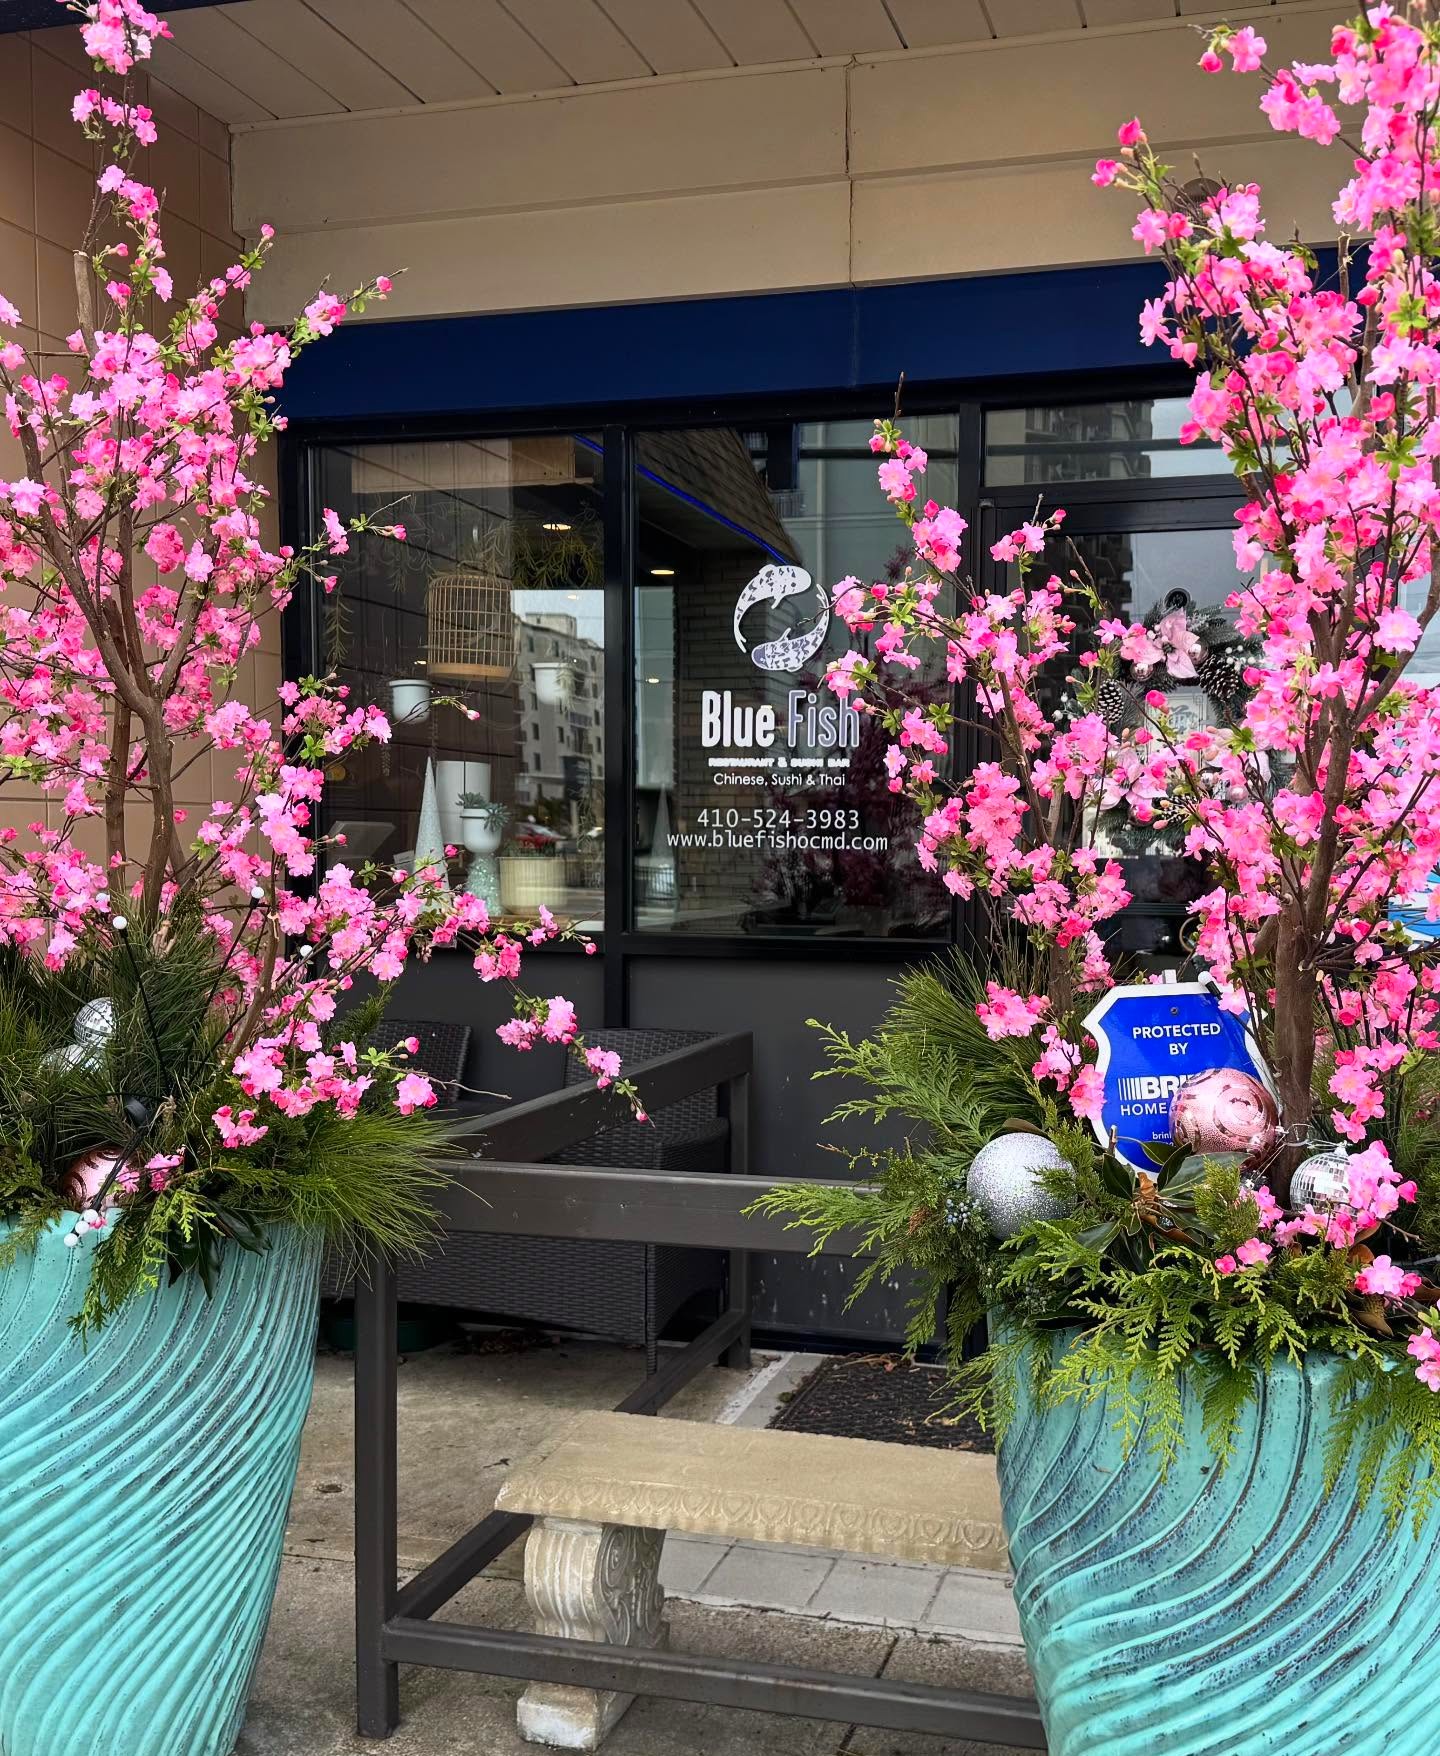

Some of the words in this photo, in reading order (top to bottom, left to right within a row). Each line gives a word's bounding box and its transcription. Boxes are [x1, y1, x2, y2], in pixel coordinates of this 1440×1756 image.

[701, 690, 775, 747] Blue
[787, 690, 860, 748] Fish
[713, 773, 768, 786] Chinese,
[771, 773, 802, 786] Sushi
[806, 774, 815, 785] &
[819, 773, 845, 786] Thai
[697, 808, 860, 829] 410-524-3983
[666, 829, 888, 850] www.bluefishocmd.com
[1132, 1023, 1221, 1039] PROTECTED
[1169, 1042, 1188, 1055] BY
[1120, 1103, 1168, 1116] HOME
